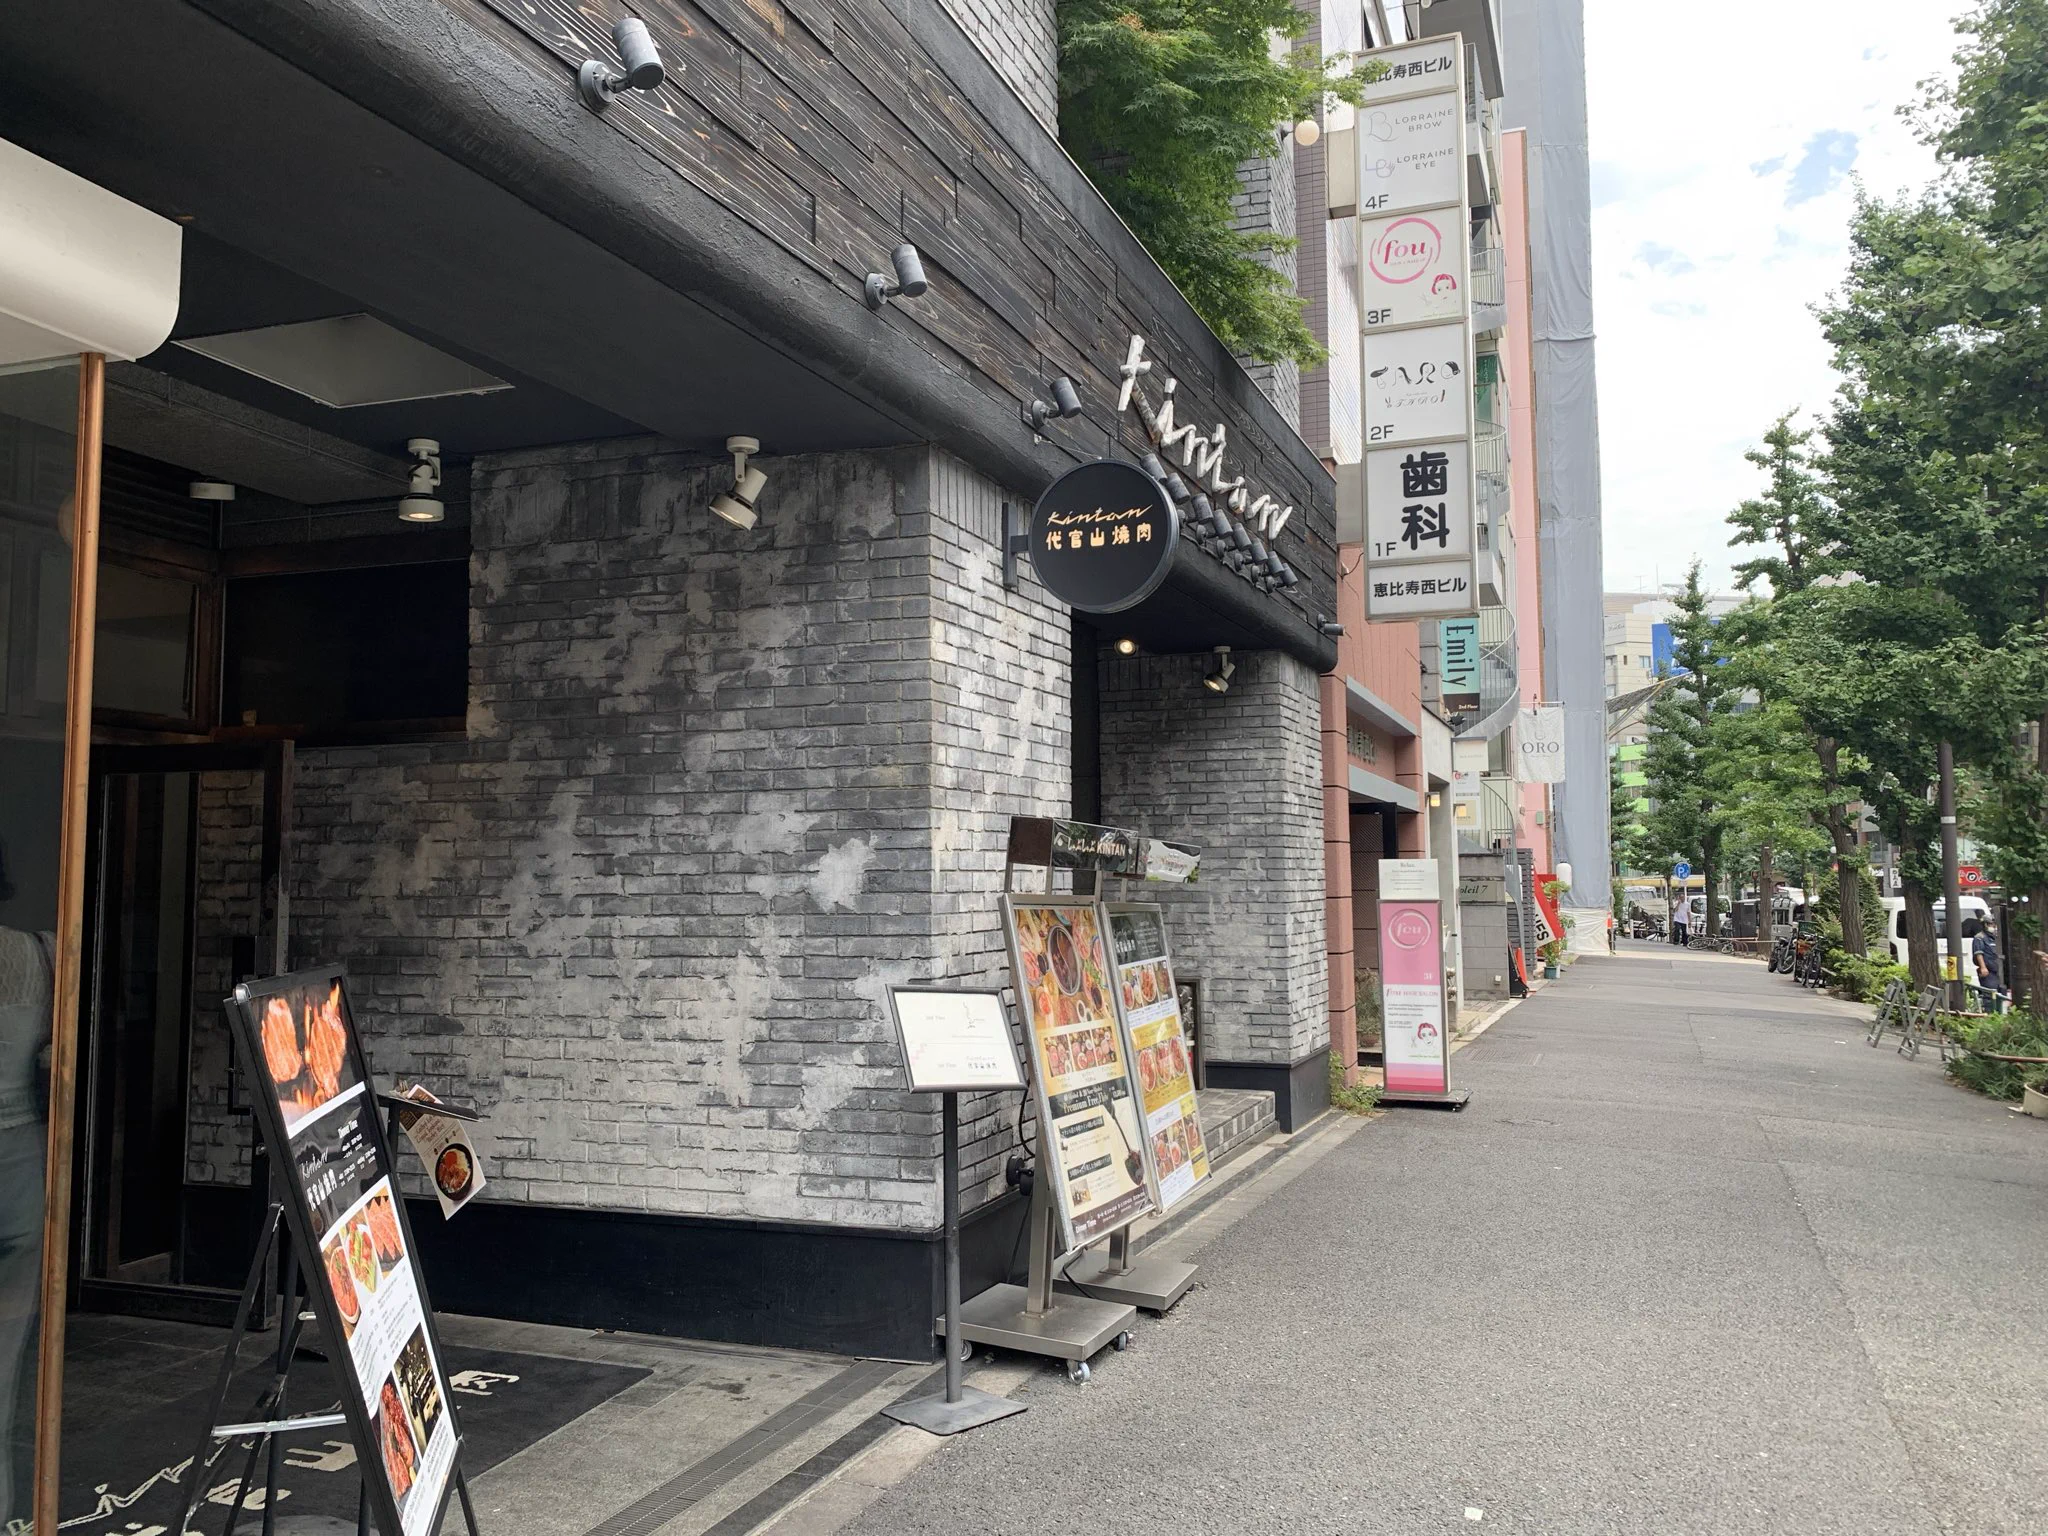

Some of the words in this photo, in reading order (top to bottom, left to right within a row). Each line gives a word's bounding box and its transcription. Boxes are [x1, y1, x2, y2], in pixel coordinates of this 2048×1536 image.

[1364, 56, 1453, 84] 比寿西ビル
[1395, 108, 1453, 125] LORRAINE
[1408, 120, 1442, 132] BROW
[1396, 147, 1454, 164] LORRAINE
[1415, 160, 1436, 170] EYE
[1365, 194, 1389, 209] 4F
[1384, 240, 1426, 264] fou
[1367, 308, 1392, 324] 3F
[1370, 424, 1394, 440] 2F
[1400, 451, 1450, 550] 歯科
[1375, 541, 1397, 556] 1F
[1373, 577, 1467, 598] 恵比寿西ビル
[1441, 624, 1475, 687] Emily
[1521, 741, 1559, 754] ORO
[1096, 840, 1127, 857] KINTAN
